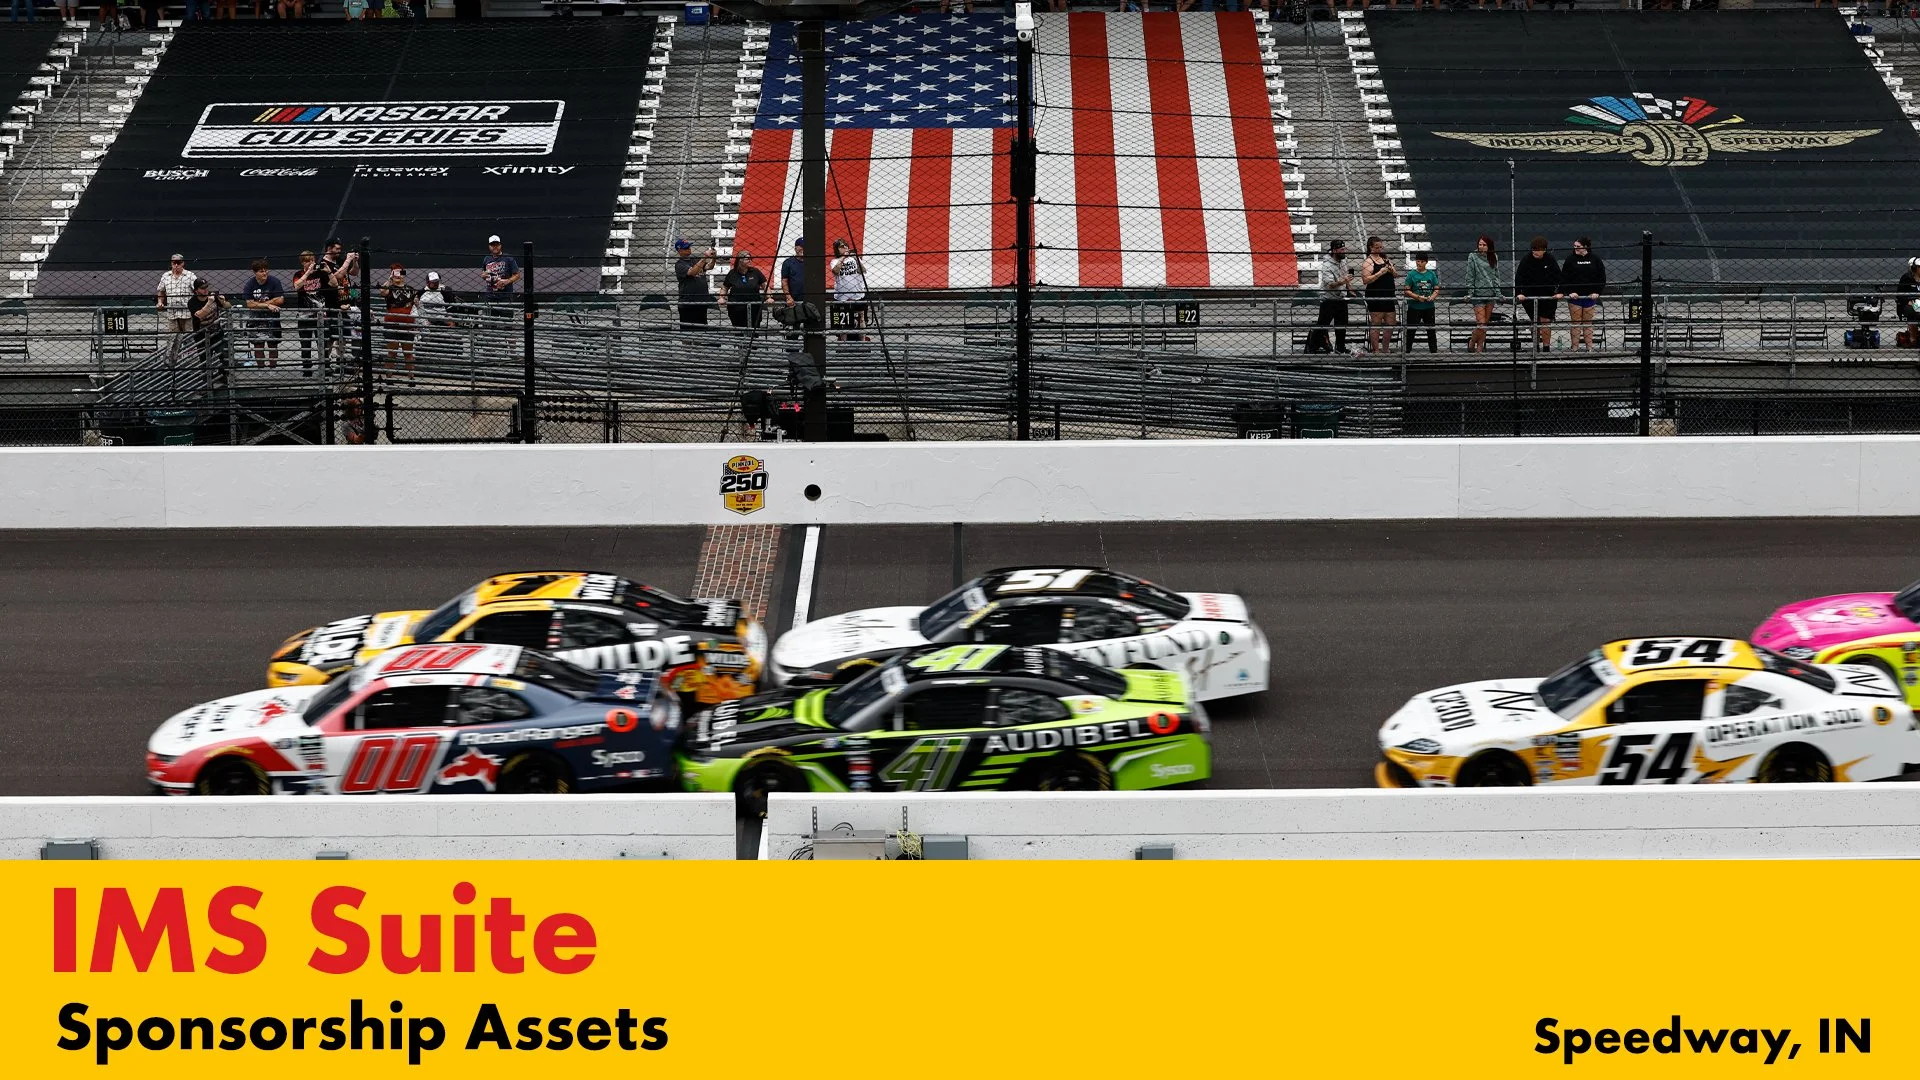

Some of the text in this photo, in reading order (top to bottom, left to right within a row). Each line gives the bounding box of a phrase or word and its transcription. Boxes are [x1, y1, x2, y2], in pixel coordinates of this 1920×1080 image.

[313, 105, 511, 123] NASCAR
[238, 128, 508, 145] CUP SERIES
[1488, 136, 1637, 148] INDIANAPOLIS
[1664, 124, 1703, 161] MOTOR
[1720, 136, 1832, 147] SPEEDWAY
[143, 169, 210, 178] BUSCH
[114, 316, 126, 331] 19
[840, 312, 850, 325] 21
[1185, 309, 1197, 323] 22
[720, 472, 768, 494] 250
[997, 568, 1094, 593] 51
[381, 646, 482, 672] 00
[553, 634, 695, 671] WILDE
[907, 644, 1011, 672] 41
[1631, 638, 1727, 666] 54
[983, 719, 1155, 754] AUDIBEL
[1704, 711, 1820, 743] OPERATION
[340, 735, 443, 793] 00
[877, 736, 971, 791] 41
[1598, 731, 1696, 785] 54
